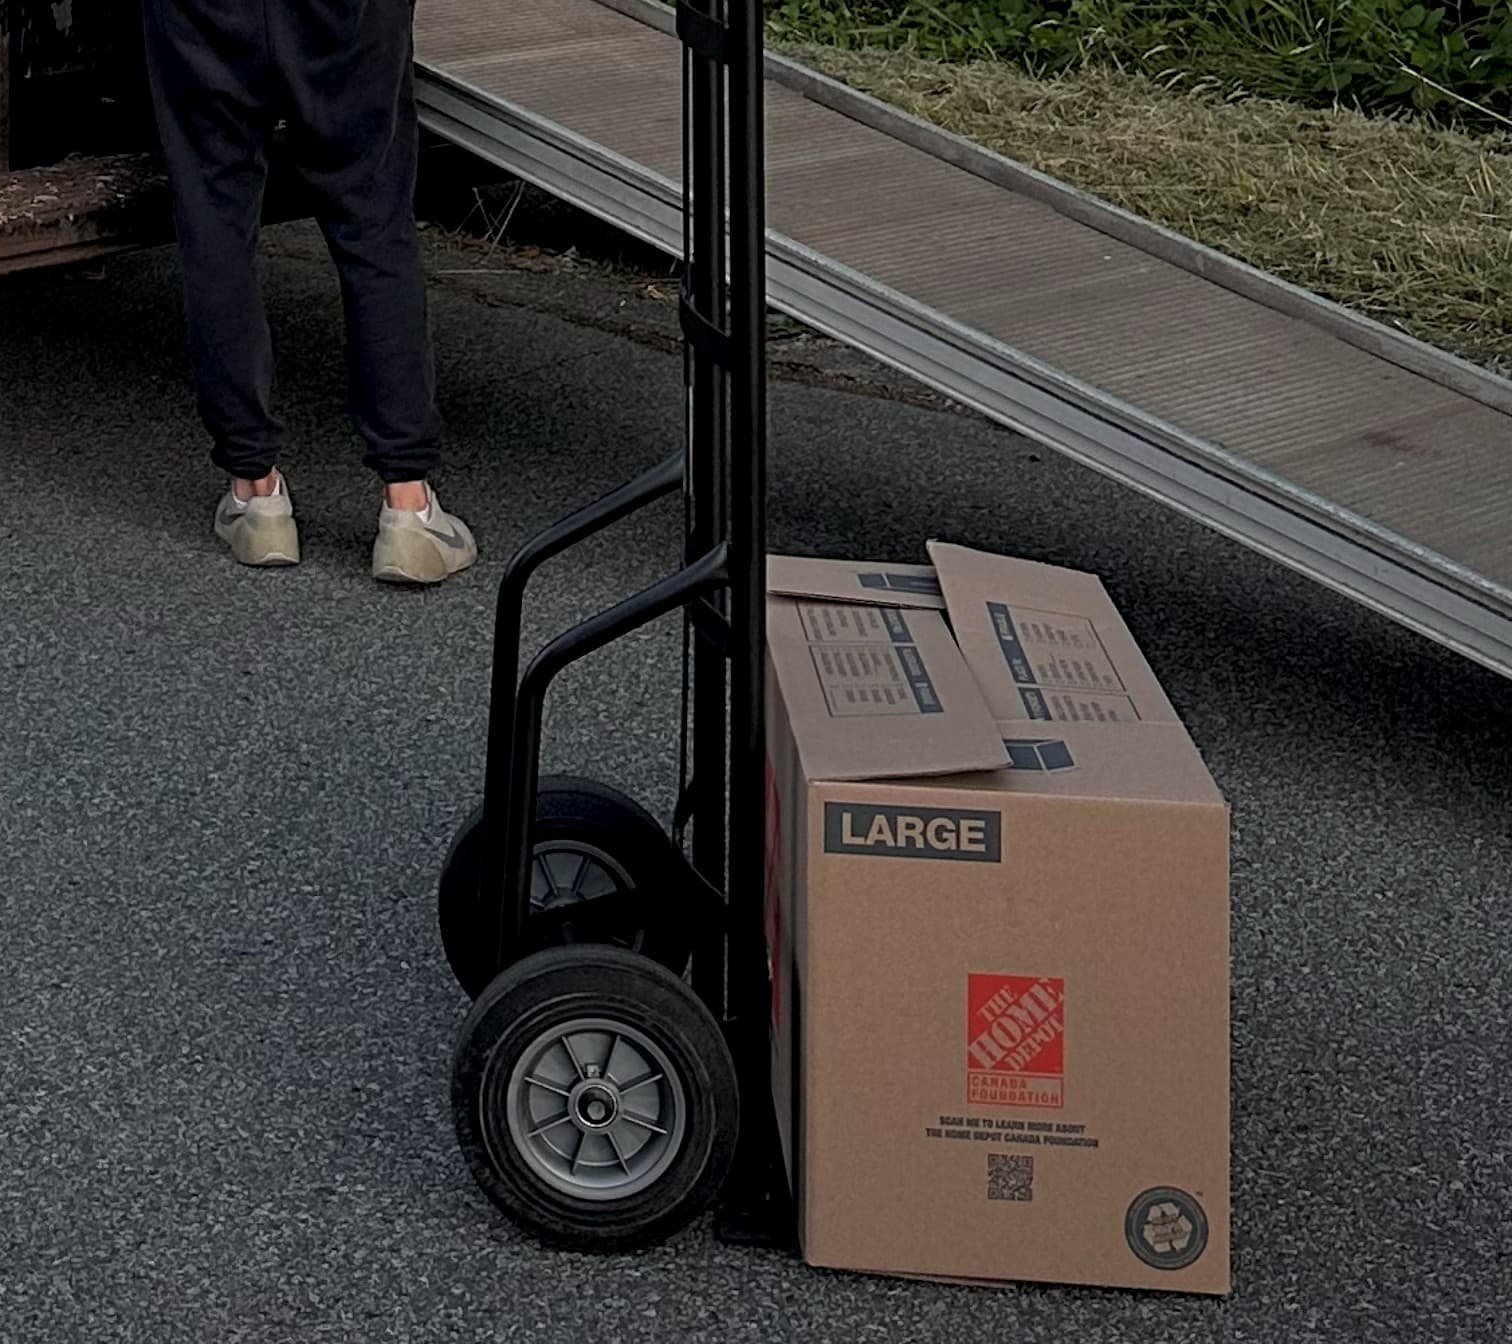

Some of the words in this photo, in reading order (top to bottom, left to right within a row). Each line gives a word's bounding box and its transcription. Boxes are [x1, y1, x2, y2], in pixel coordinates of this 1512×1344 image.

[842, 812, 986, 852] LARGE
[977, 984, 1018, 1023] THE
[968, 977, 1064, 1070] HOME
[1005, 1013, 1064, 1072] DEPOT
[972, 1076, 1027, 1089] CANADA
[972, 1090, 1059, 1105] FOUNDATION
[982, 1119, 993, 1129] TO
[995, 1120, 1025, 1131] LEARN
[1056, 1123, 1087, 1134] ABOUT
